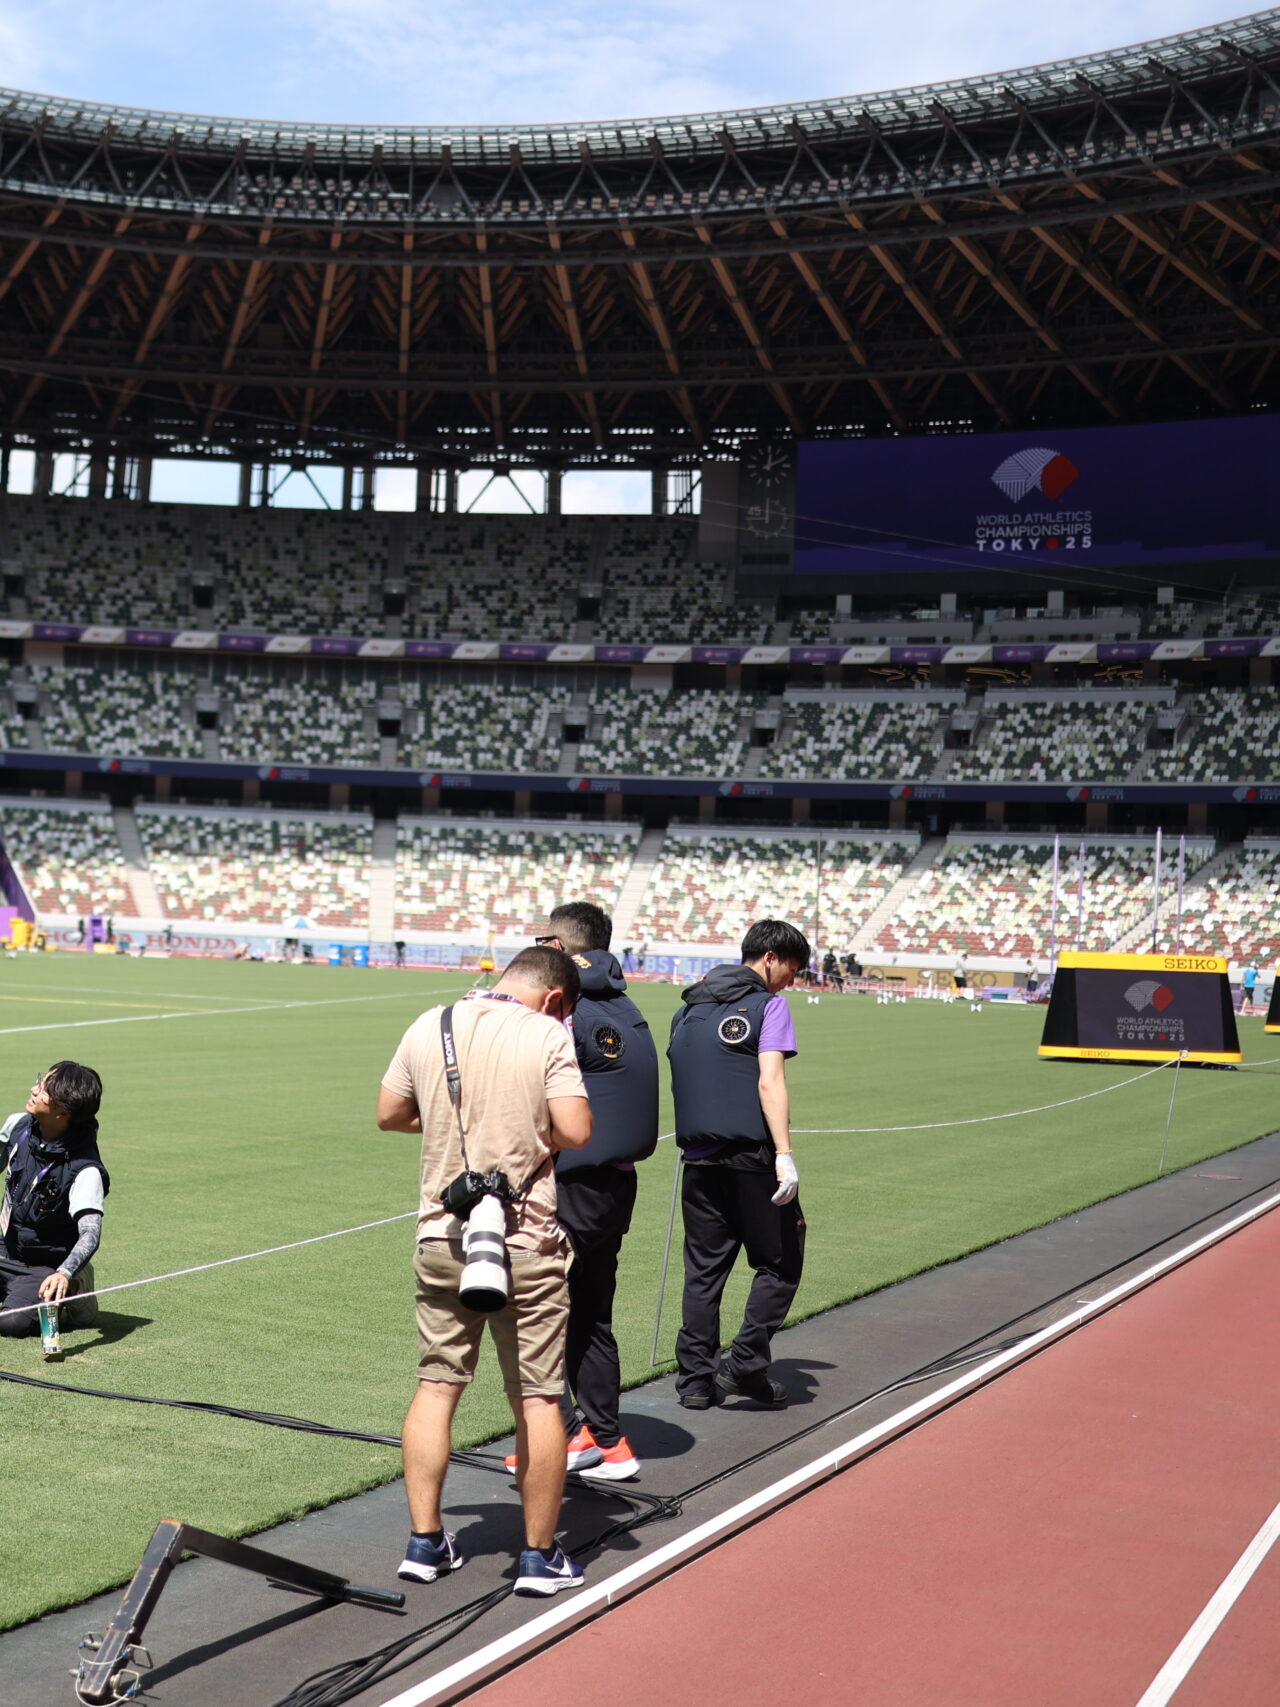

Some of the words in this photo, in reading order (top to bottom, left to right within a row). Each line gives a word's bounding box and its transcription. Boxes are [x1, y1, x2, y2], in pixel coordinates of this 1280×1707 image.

[976, 514, 1022, 525] WORLD
[1024, 511, 1093, 523] ATHLETICS
[975, 523, 1092, 538] CHAMPIONSHIPS
[1065, 536, 1092, 549] 25
[145, 934, 238, 949] HONDA
[1164, 958, 1218, 970] SEIKO
[917, 968, 997, 988] SEKO
[1116, 1017, 1143, 1025] WORLD
[1144, 1018, 1184, 1026] ATHLETICS
[1116, 1024, 1185, 1033] CHAMPIONSHIPS
[443, 1032, 455, 1065] SONY
